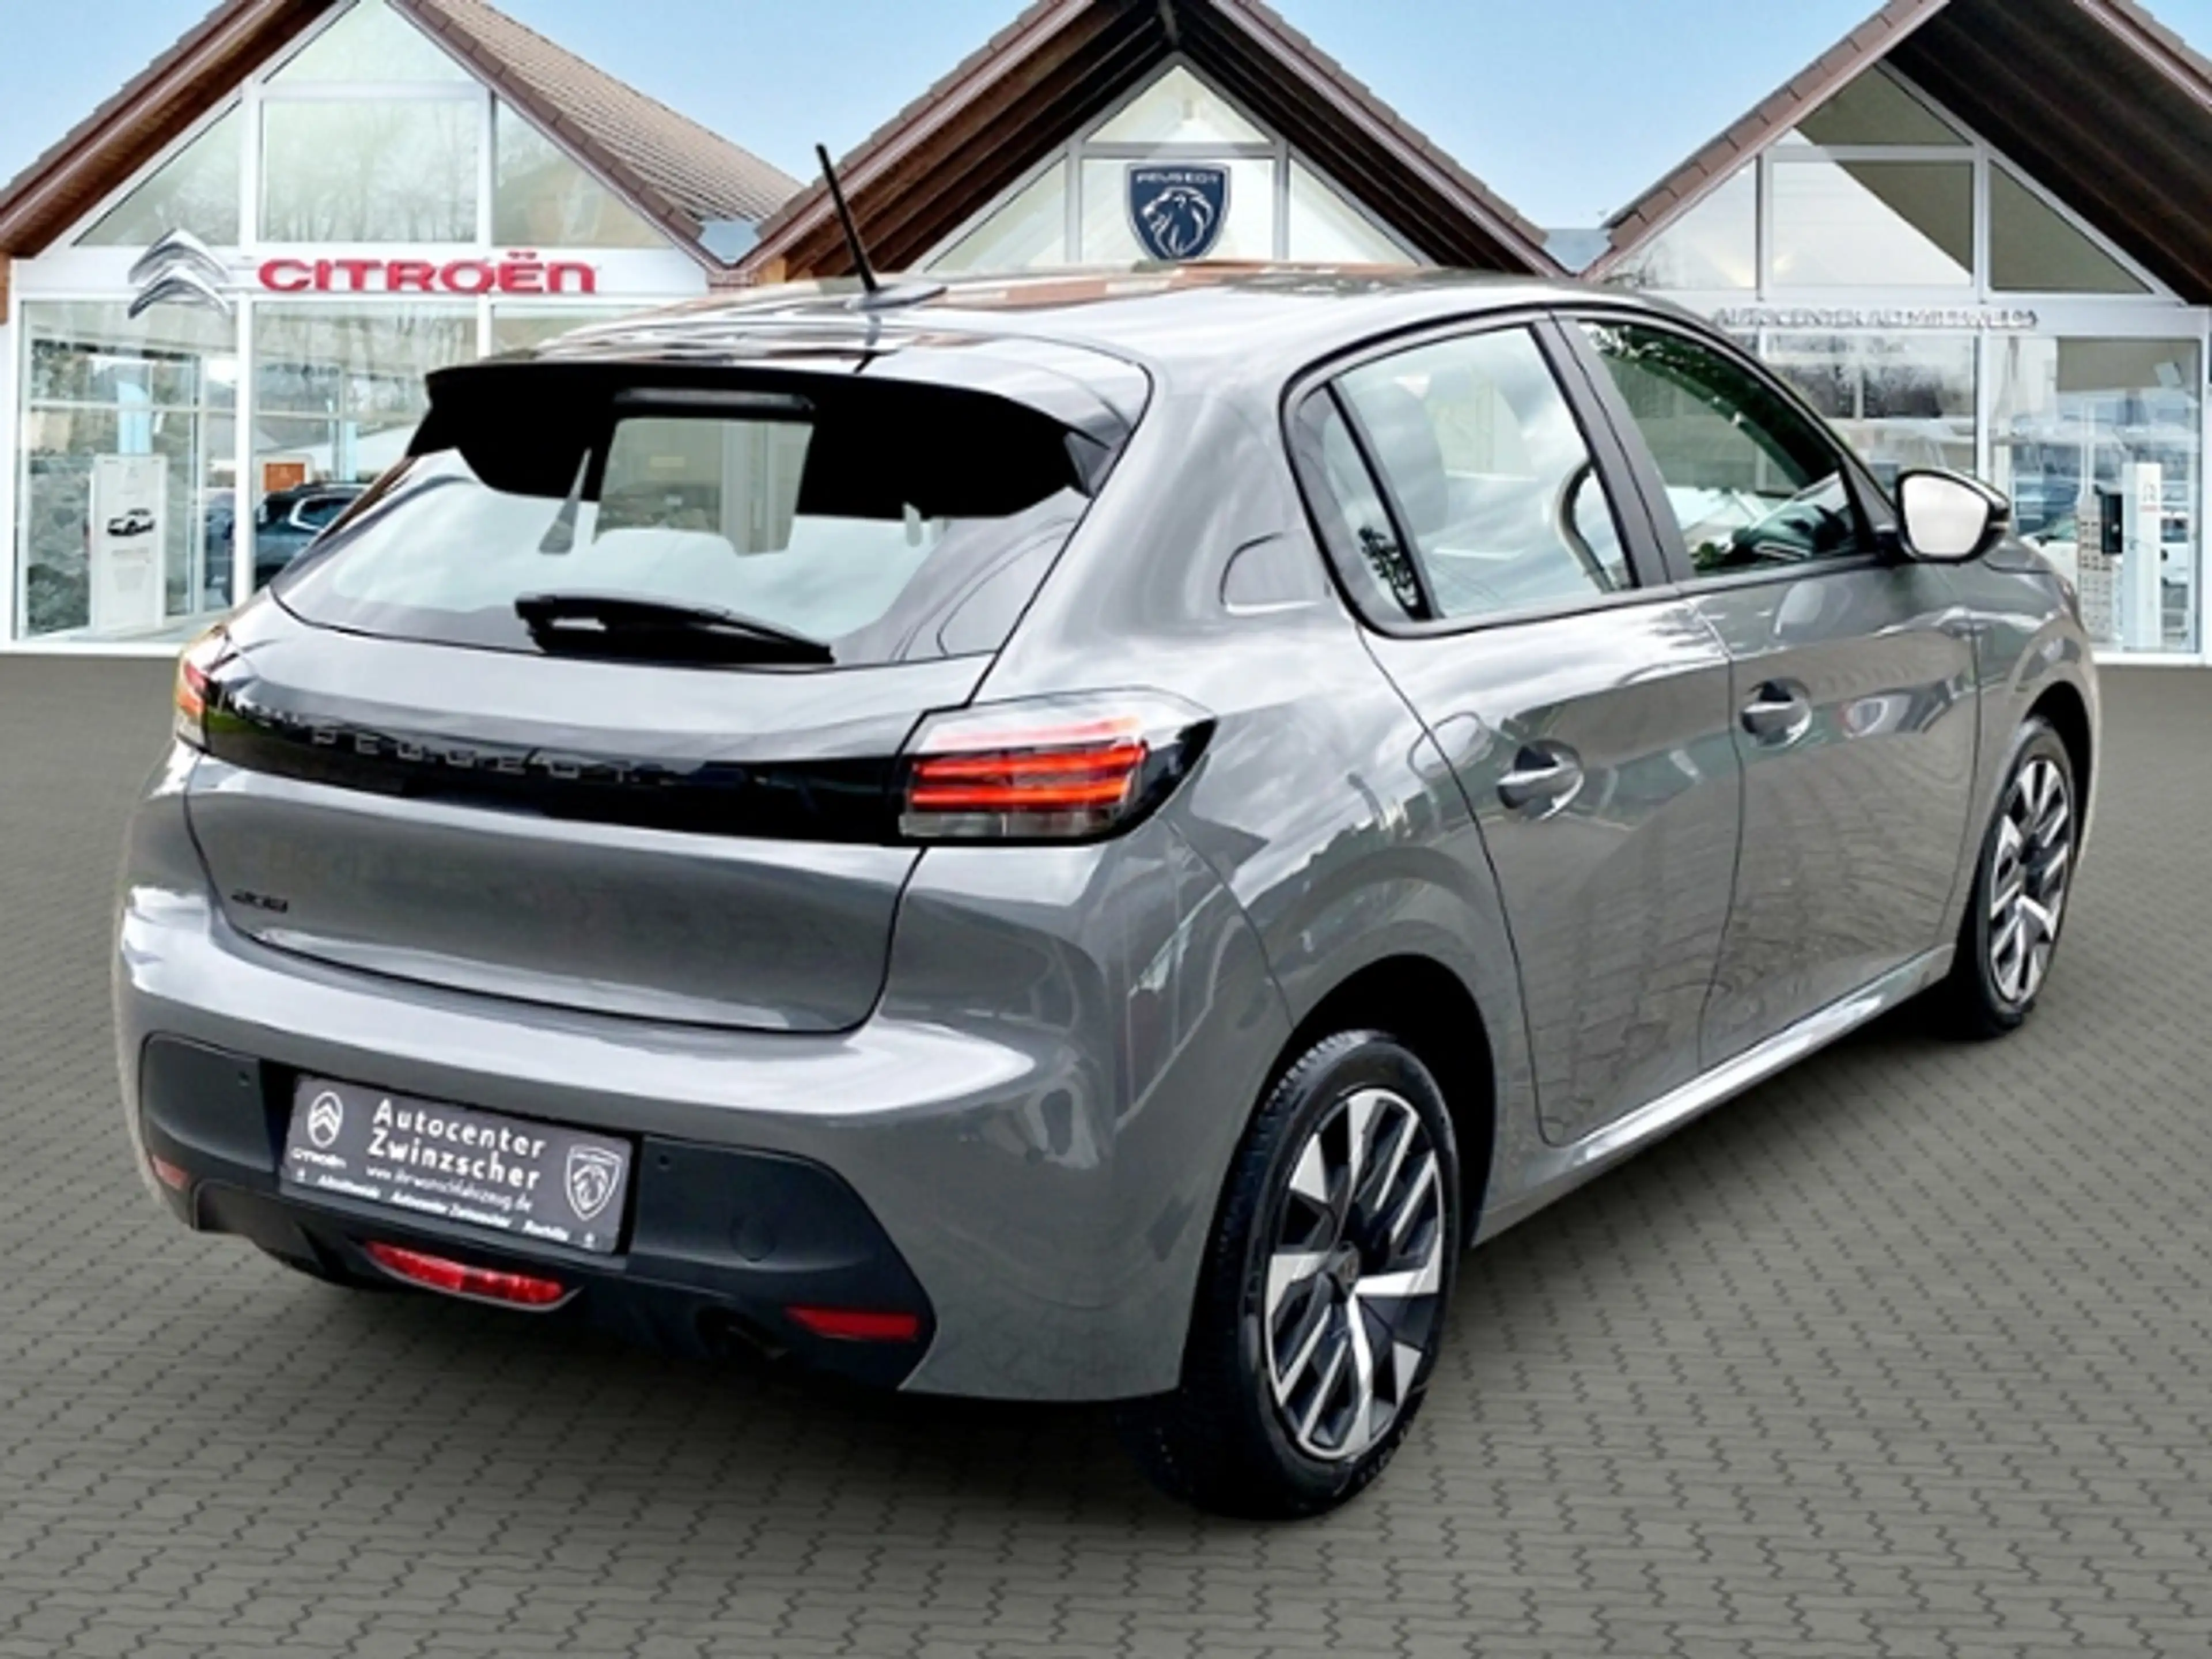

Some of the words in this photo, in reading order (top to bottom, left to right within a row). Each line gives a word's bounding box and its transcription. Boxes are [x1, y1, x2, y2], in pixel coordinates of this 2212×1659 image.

[257, 251, 596, 294] CITROËN
[373, 1099, 546, 1158] Autocenter
[368, 1128, 540, 1190] Zwinzscher
